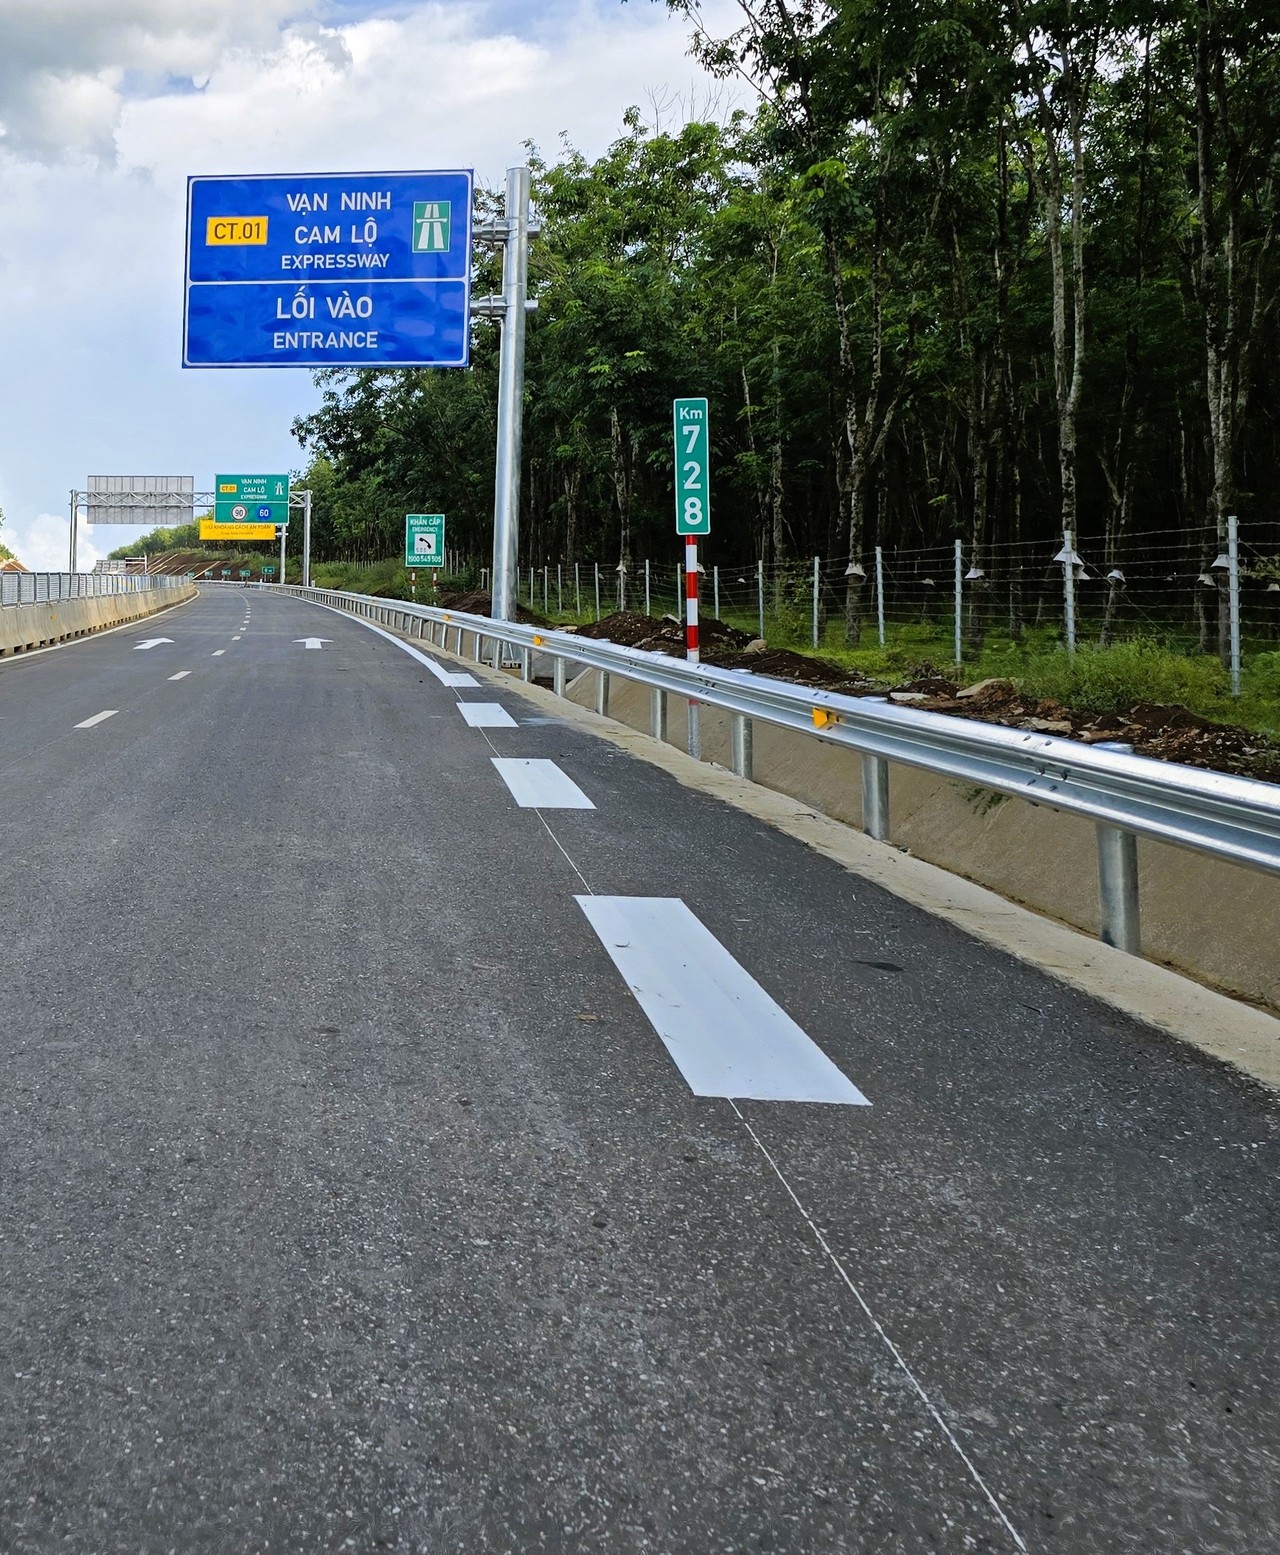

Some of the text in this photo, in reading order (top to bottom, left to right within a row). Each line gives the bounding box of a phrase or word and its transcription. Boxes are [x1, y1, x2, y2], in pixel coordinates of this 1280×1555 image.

[286, 191, 392, 216] VẠN NINH
[213, 221, 262, 241] CT.01
[294, 216, 378, 248] CAM LỘ
[280, 253, 391, 270] EXPRESSWAY
[275, 284, 374, 320] LỐI VÀO
[272, 330, 379, 350] ENTRANCE
[679, 406, 703, 420] Km
[234, 509, 244, 517] 90
[259, 508, 269, 517] 60
